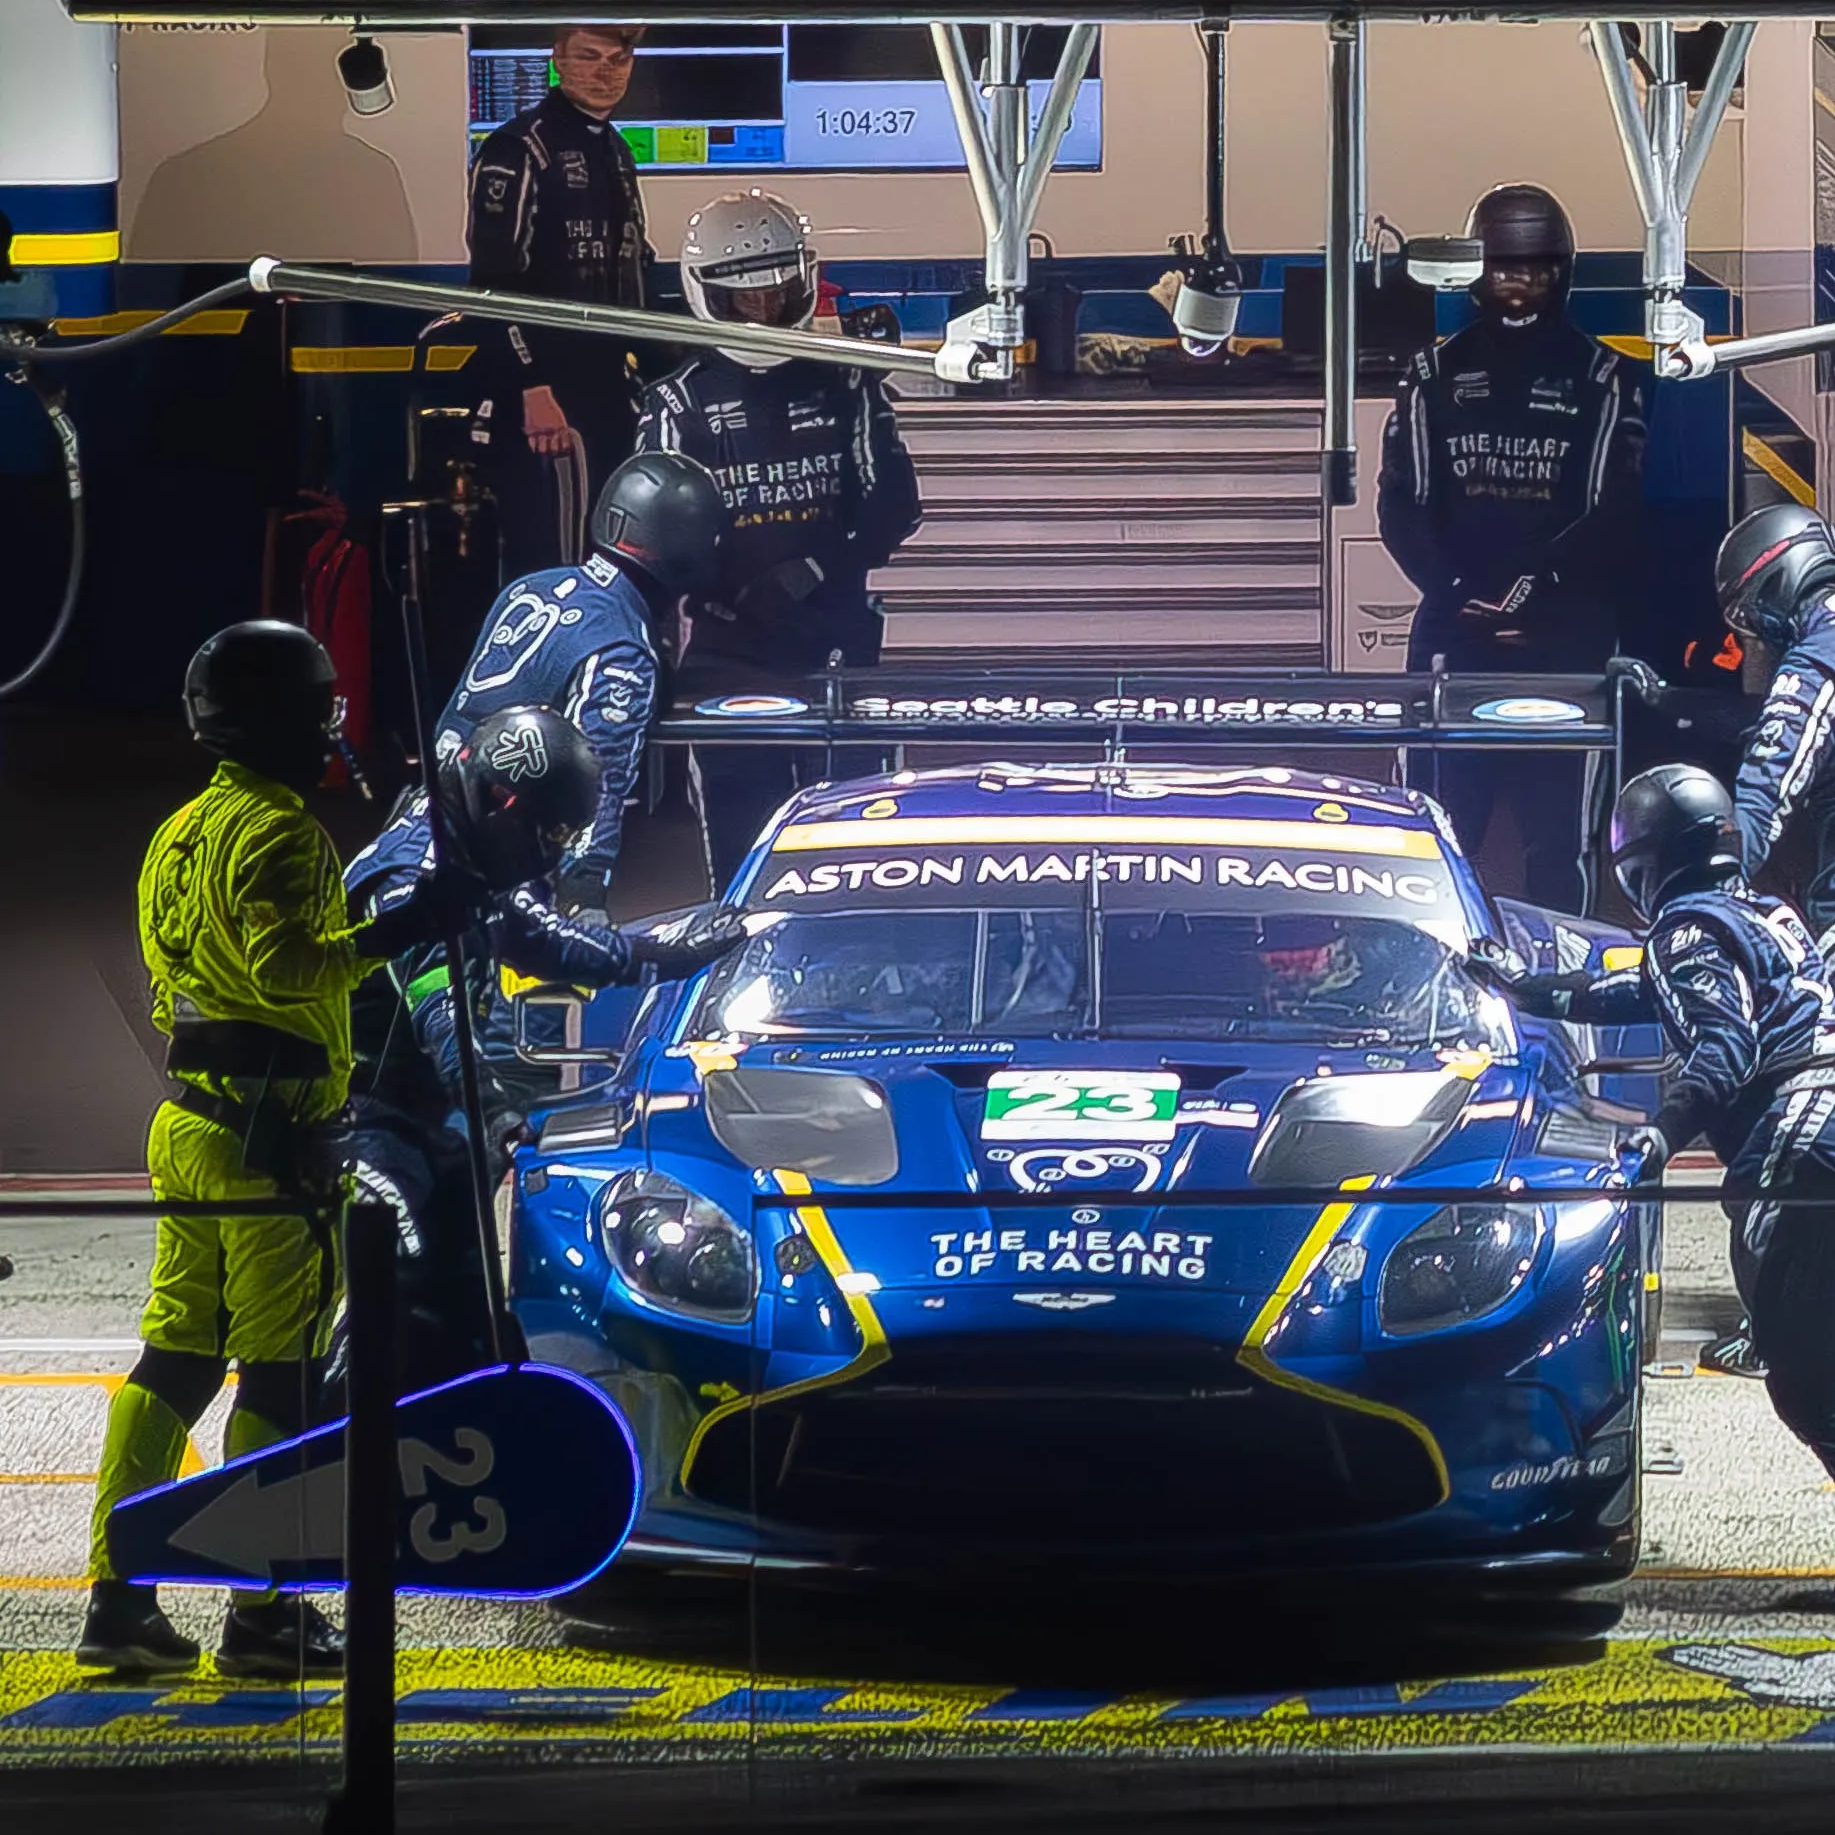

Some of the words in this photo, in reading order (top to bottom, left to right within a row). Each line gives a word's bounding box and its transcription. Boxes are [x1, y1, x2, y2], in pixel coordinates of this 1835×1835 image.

[816, 108, 918, 137] 1:04:37
[851, 697, 1079, 715] Seattle
[1092, 697, 1403, 717] Children's
[764, 855, 965, 900] ASTON
[975, 855, 1203, 885] MARTIN
[1217, 856, 1441, 904] RACING
[1001, 1085, 1158, 1122] 23
[930, 1229, 1028, 1255] THE
[1048, 1229, 1214, 1257] HEART
[934, 1250, 998, 1278] OF
[1016, 1249, 1207, 1279] RACING
[397, 1426, 508, 1563] 23
